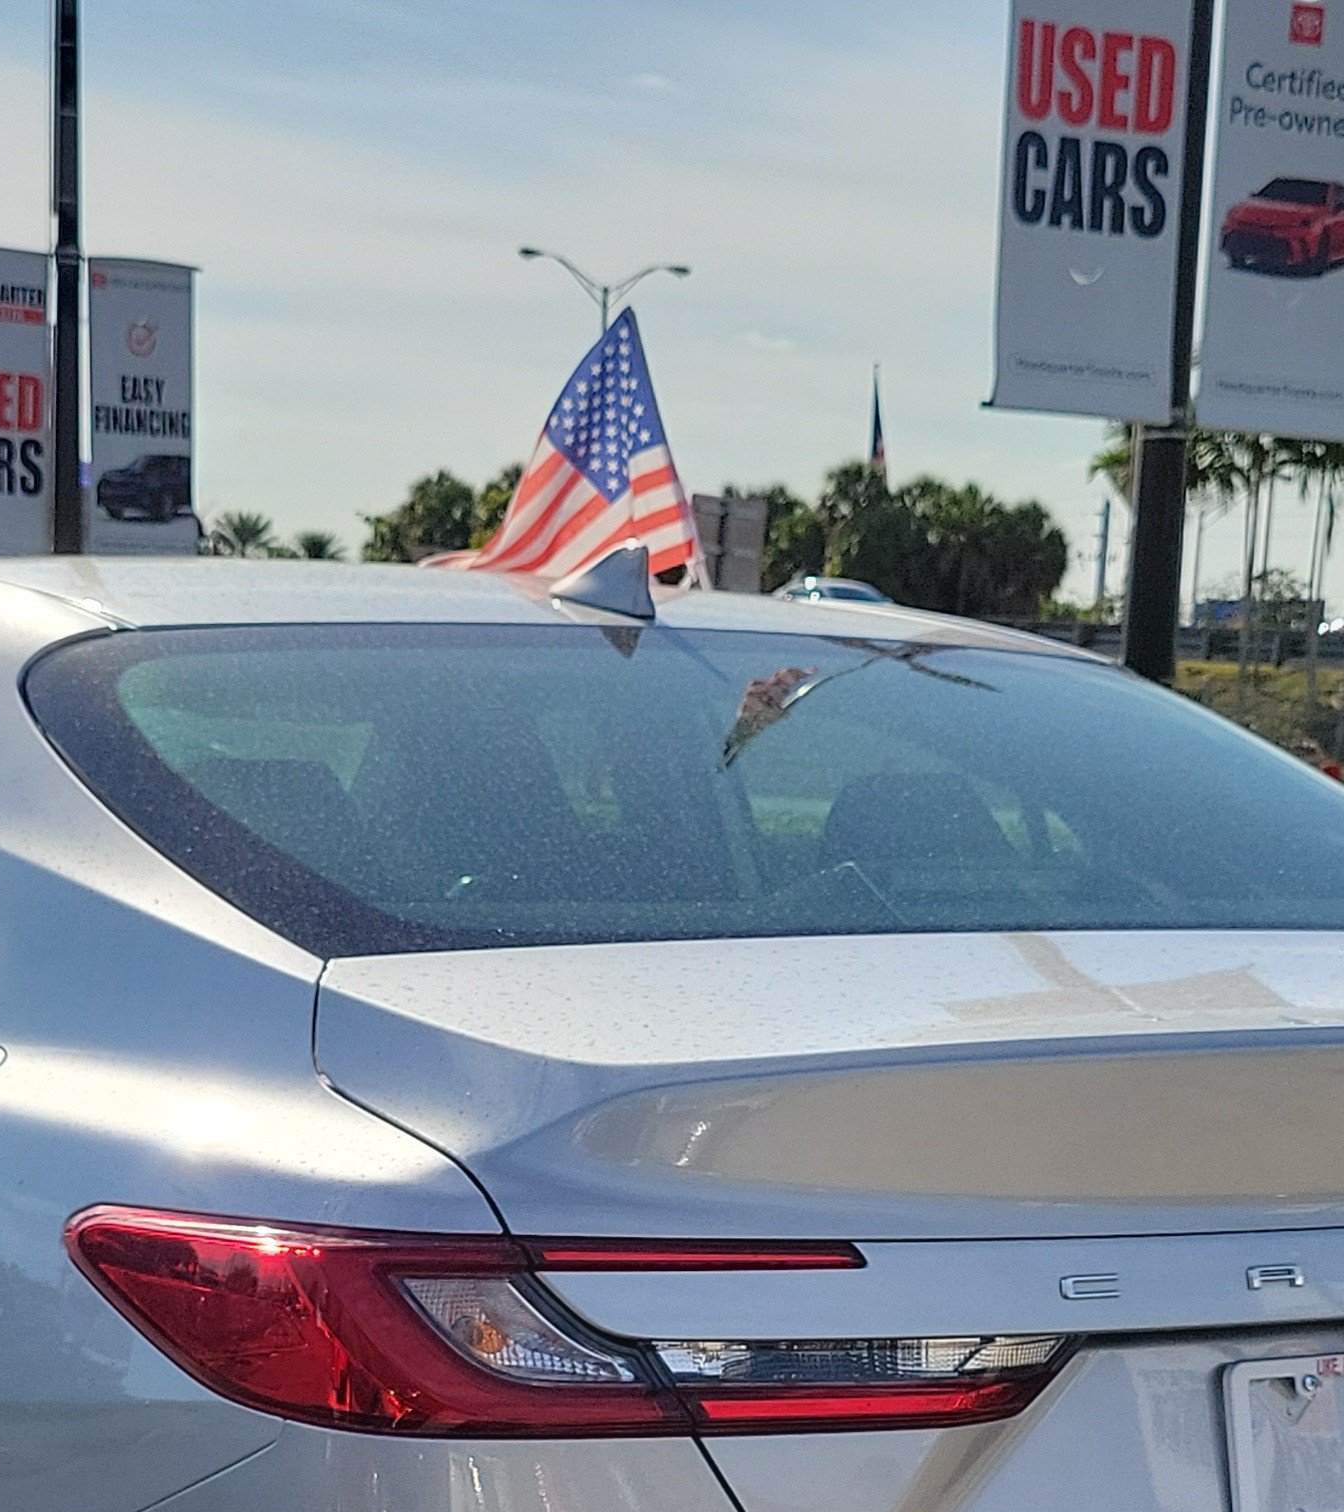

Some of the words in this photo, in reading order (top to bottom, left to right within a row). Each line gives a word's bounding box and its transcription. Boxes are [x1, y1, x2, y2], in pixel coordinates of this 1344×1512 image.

[1017, 19, 1175, 134] USED
[1013, 130, 1170, 239] CARS
[121, 374, 166, 404] EASY
[95, 405, 190, 439] FINANCING
[1316, 1357, 1338, 1375] LIKE
